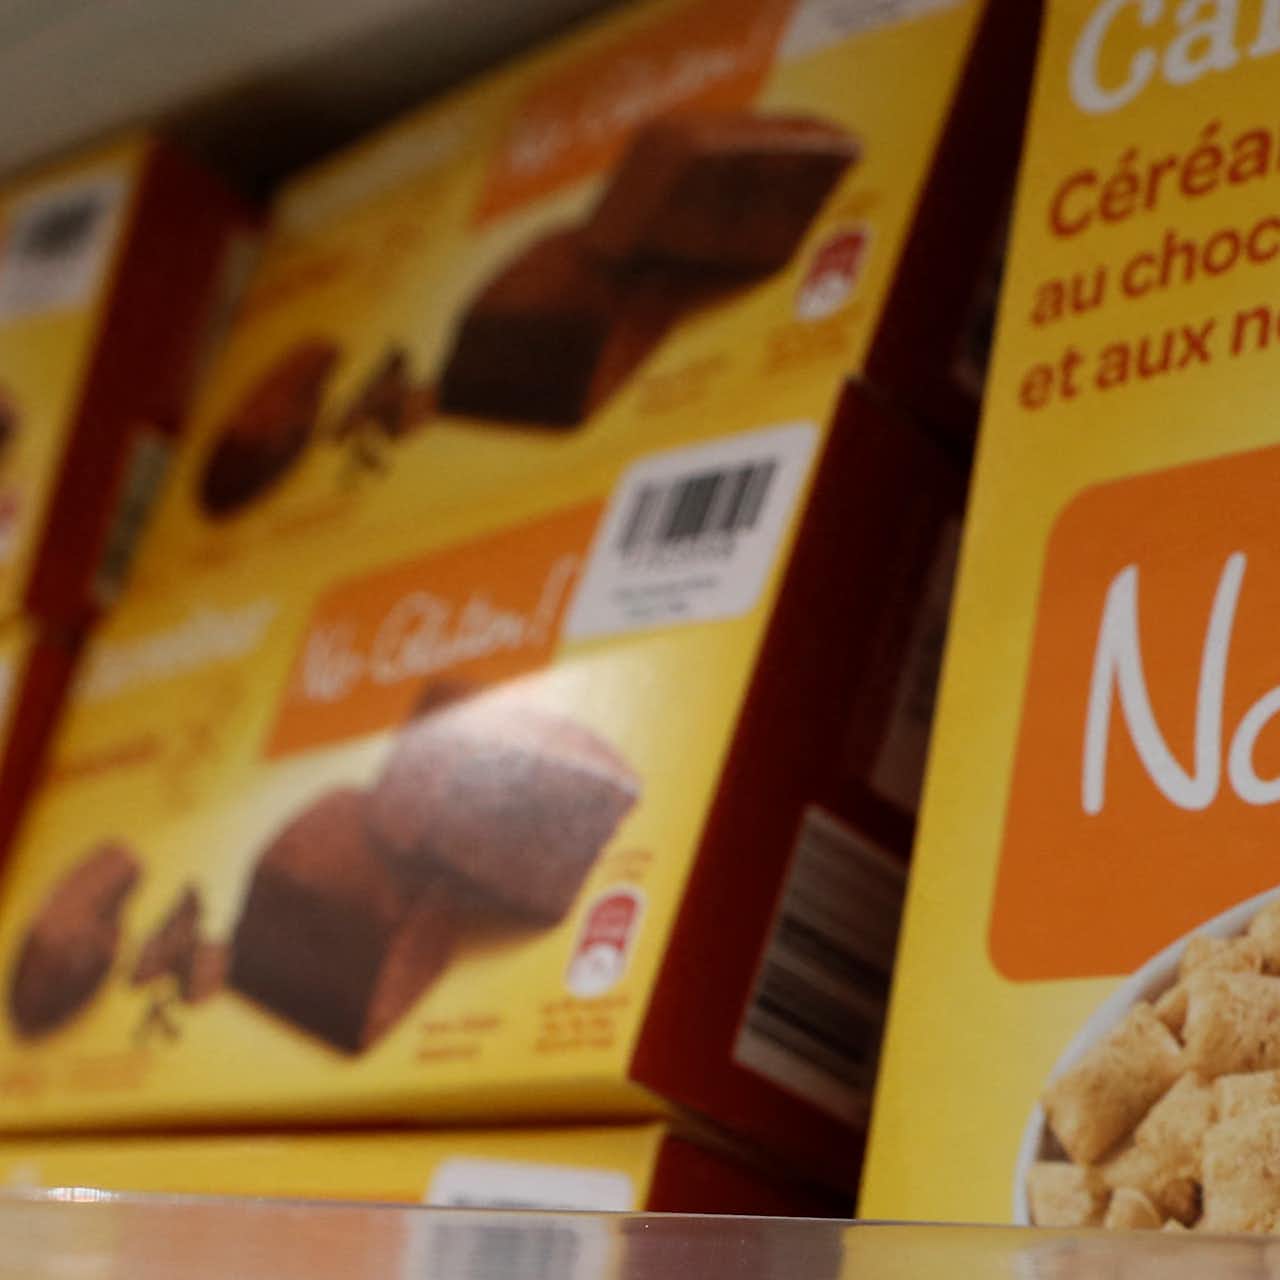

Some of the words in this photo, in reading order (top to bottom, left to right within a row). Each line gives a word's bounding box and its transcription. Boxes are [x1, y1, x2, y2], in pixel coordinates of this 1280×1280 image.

[1029, 263, 1106, 328] au
[1017, 349, 1083, 411] et
[1094, 316, 1214, 391] aux
